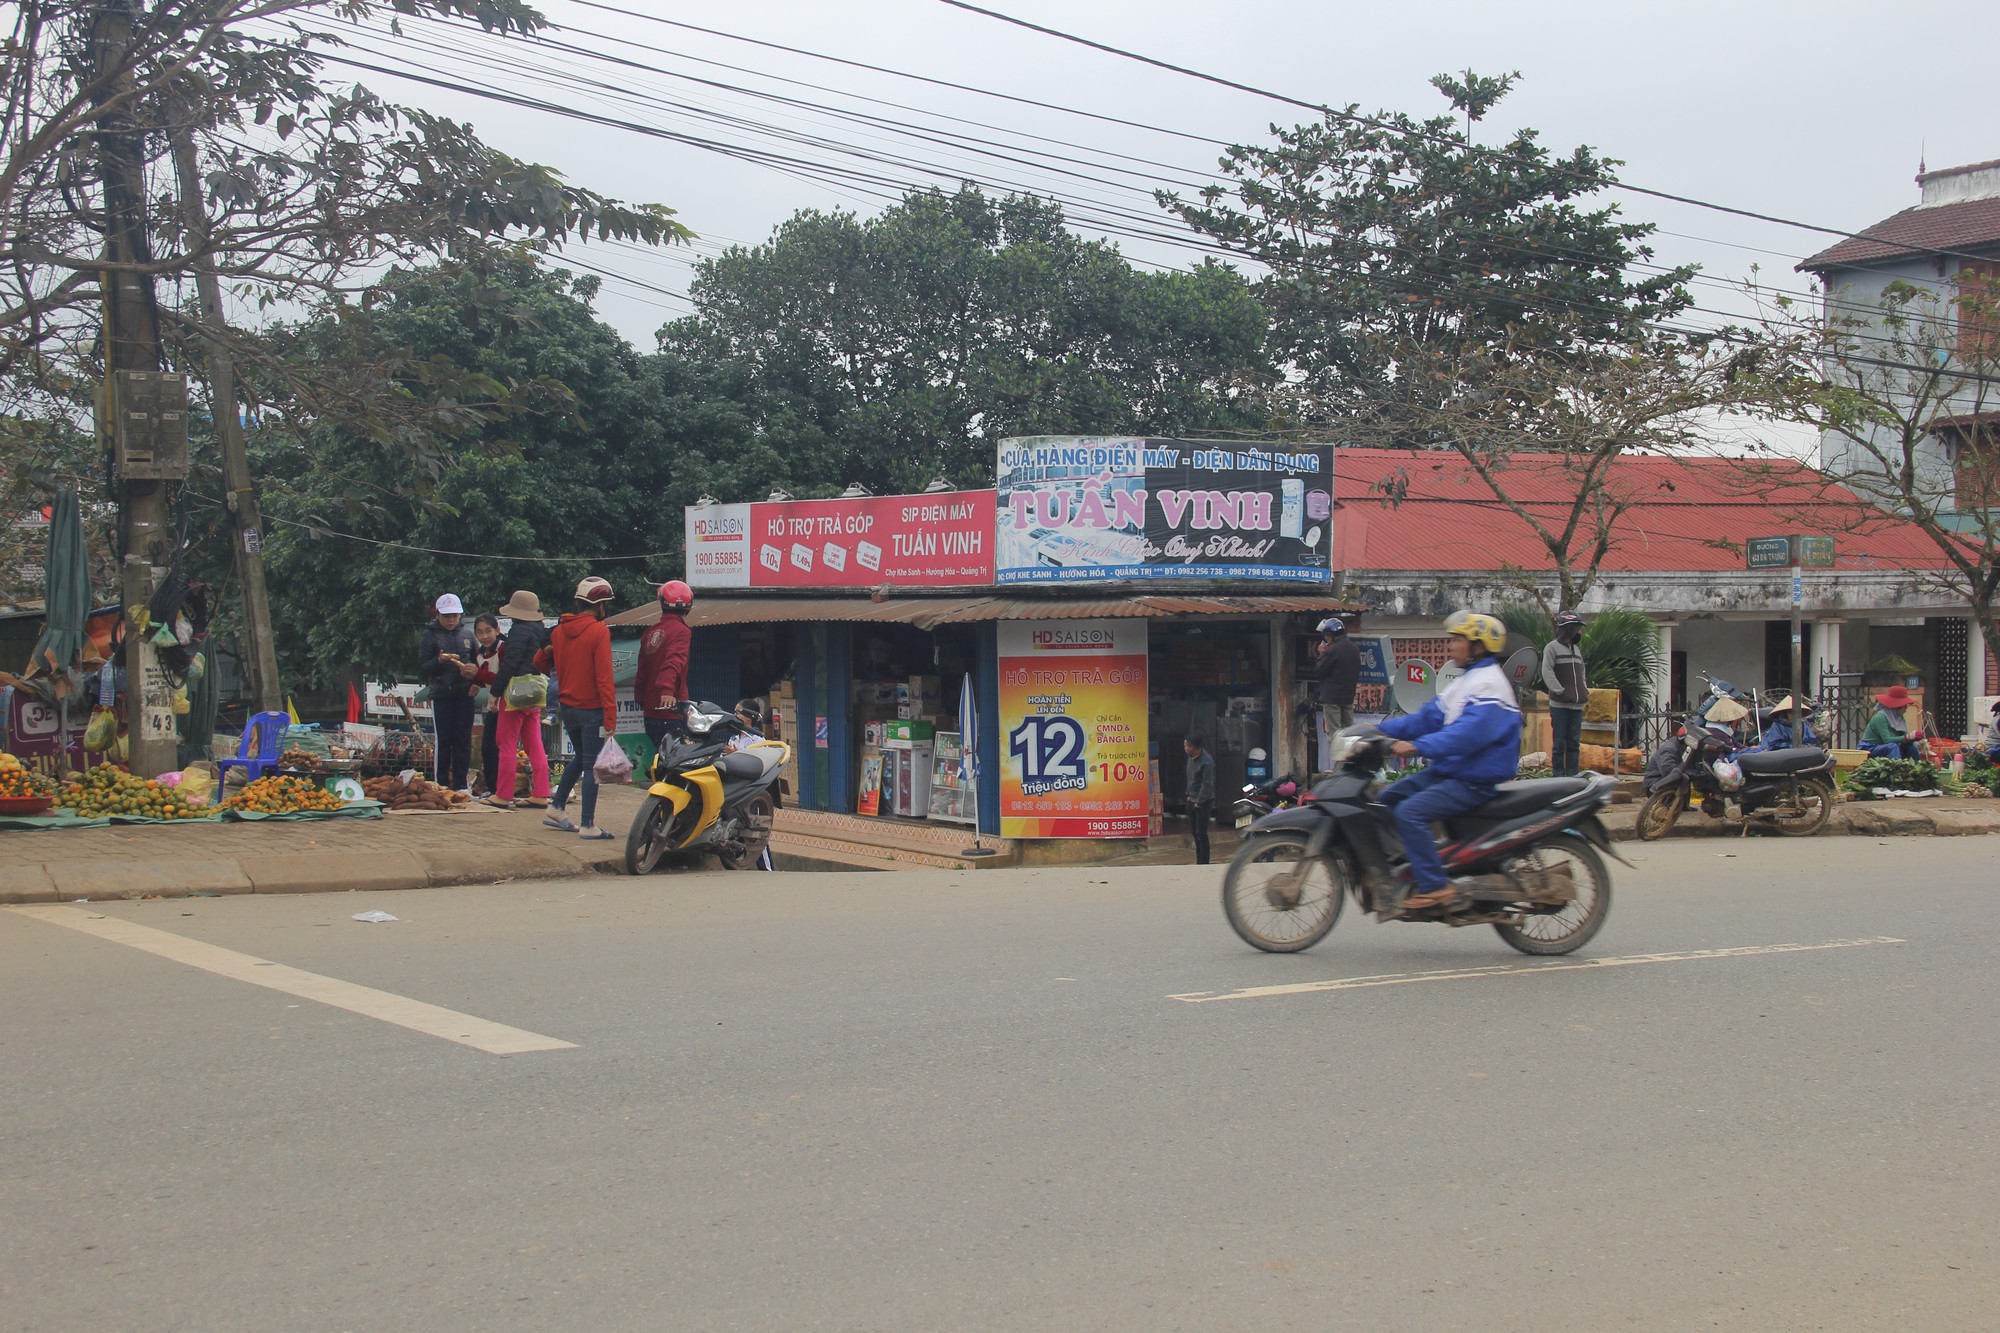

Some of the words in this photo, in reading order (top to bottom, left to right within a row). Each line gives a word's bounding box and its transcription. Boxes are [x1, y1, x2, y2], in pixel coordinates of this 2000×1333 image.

[1005, 444, 1030, 467] CỬA
[1036, 445, 1088, 466] HÀNG
[1094, 444, 1137, 470] ĐIỆN
[1142, 444, 1180, 468] MÁY
[1193, 446, 1234, 473] ĐIỆN
[1237, 447, 1272, 471] DÂN
[1274, 452, 1320, 475] DỤNG
[1009, 471, 1148, 530] TUẤN
[1156, 489, 1274, 530] VINH
[901, 507, 919, 522] SIP
[921, 504, 948, 525] ĐIỆN
[950, 500, 975, 520] MÁY
[768, 514, 785, 536] HỖ
[787, 517, 815, 540] TRỢ
[817, 512, 842, 535] TRẢ
[845, 511, 874, 534] GÓP
[892, 528, 936, 556] TUẤN
[941, 530, 982, 555] VINH
[1119, 535, 1162, 558] Chào
[1164, 534, 1204, 564] Quý
[1204, 534, 1276, 558] Khách!
[695, 553, 713, 565] 1900
[714, 552, 743, 565] 558854
[766, 552, 779, 568] 10%
[796, 554, 811, 568] 1.49%
[695, 566, 743, 575] www.hdsaison.com.vn
[885, 568, 896, 578] Chợ
[896, 568, 907, 576] Khe
[907, 567, 921, 576] Sanh
[960, 566, 979, 577] Quảng
[979, 565, 987, 577] Trị
[1017, 571, 1030, 579] KHE
[1032, 570, 1052, 579] SANH
[1059, 568, 1088, 578] HƯỚNG
[1089, 567, 1106, 577] HÓA
[1114, 566, 1139, 576] QUẢNG
[1141, 567, 1152, 577] TRỊ
[1178, 567, 1195, 575] 0982
[1196, 567, 1209, 575] 256
[1229, 567, 1246, 575] 0982
[1248, 568, 1261, 576] 798
[1261, 568, 1274, 576] 688
[1279, 569, 1296, 577] 0912
[1297, 569, 1310, 577] 450
[1311, 570, 1323, 578] 183
[1006, 667, 1029, 686] HỖ
[1033, 670, 1068, 689] TRỢ
[1071, 666, 1105, 685] TRẢ
[1410, 667, 1427, 680] K+
[1028, 694, 1053, 704] HOÀN
[1096, 724, 1123, 732] CMND
[1124, 724, 1131, 732] &
[1012, 721, 1080, 777] 12
[1100, 762, 1145, 783] 10%
[1022, 780, 1051, 796] Triệu
[1053, 774, 1086, 790] đồng
[1087, 822, 1109, 830] 1900
[1111, 821, 1142, 830] 558854
